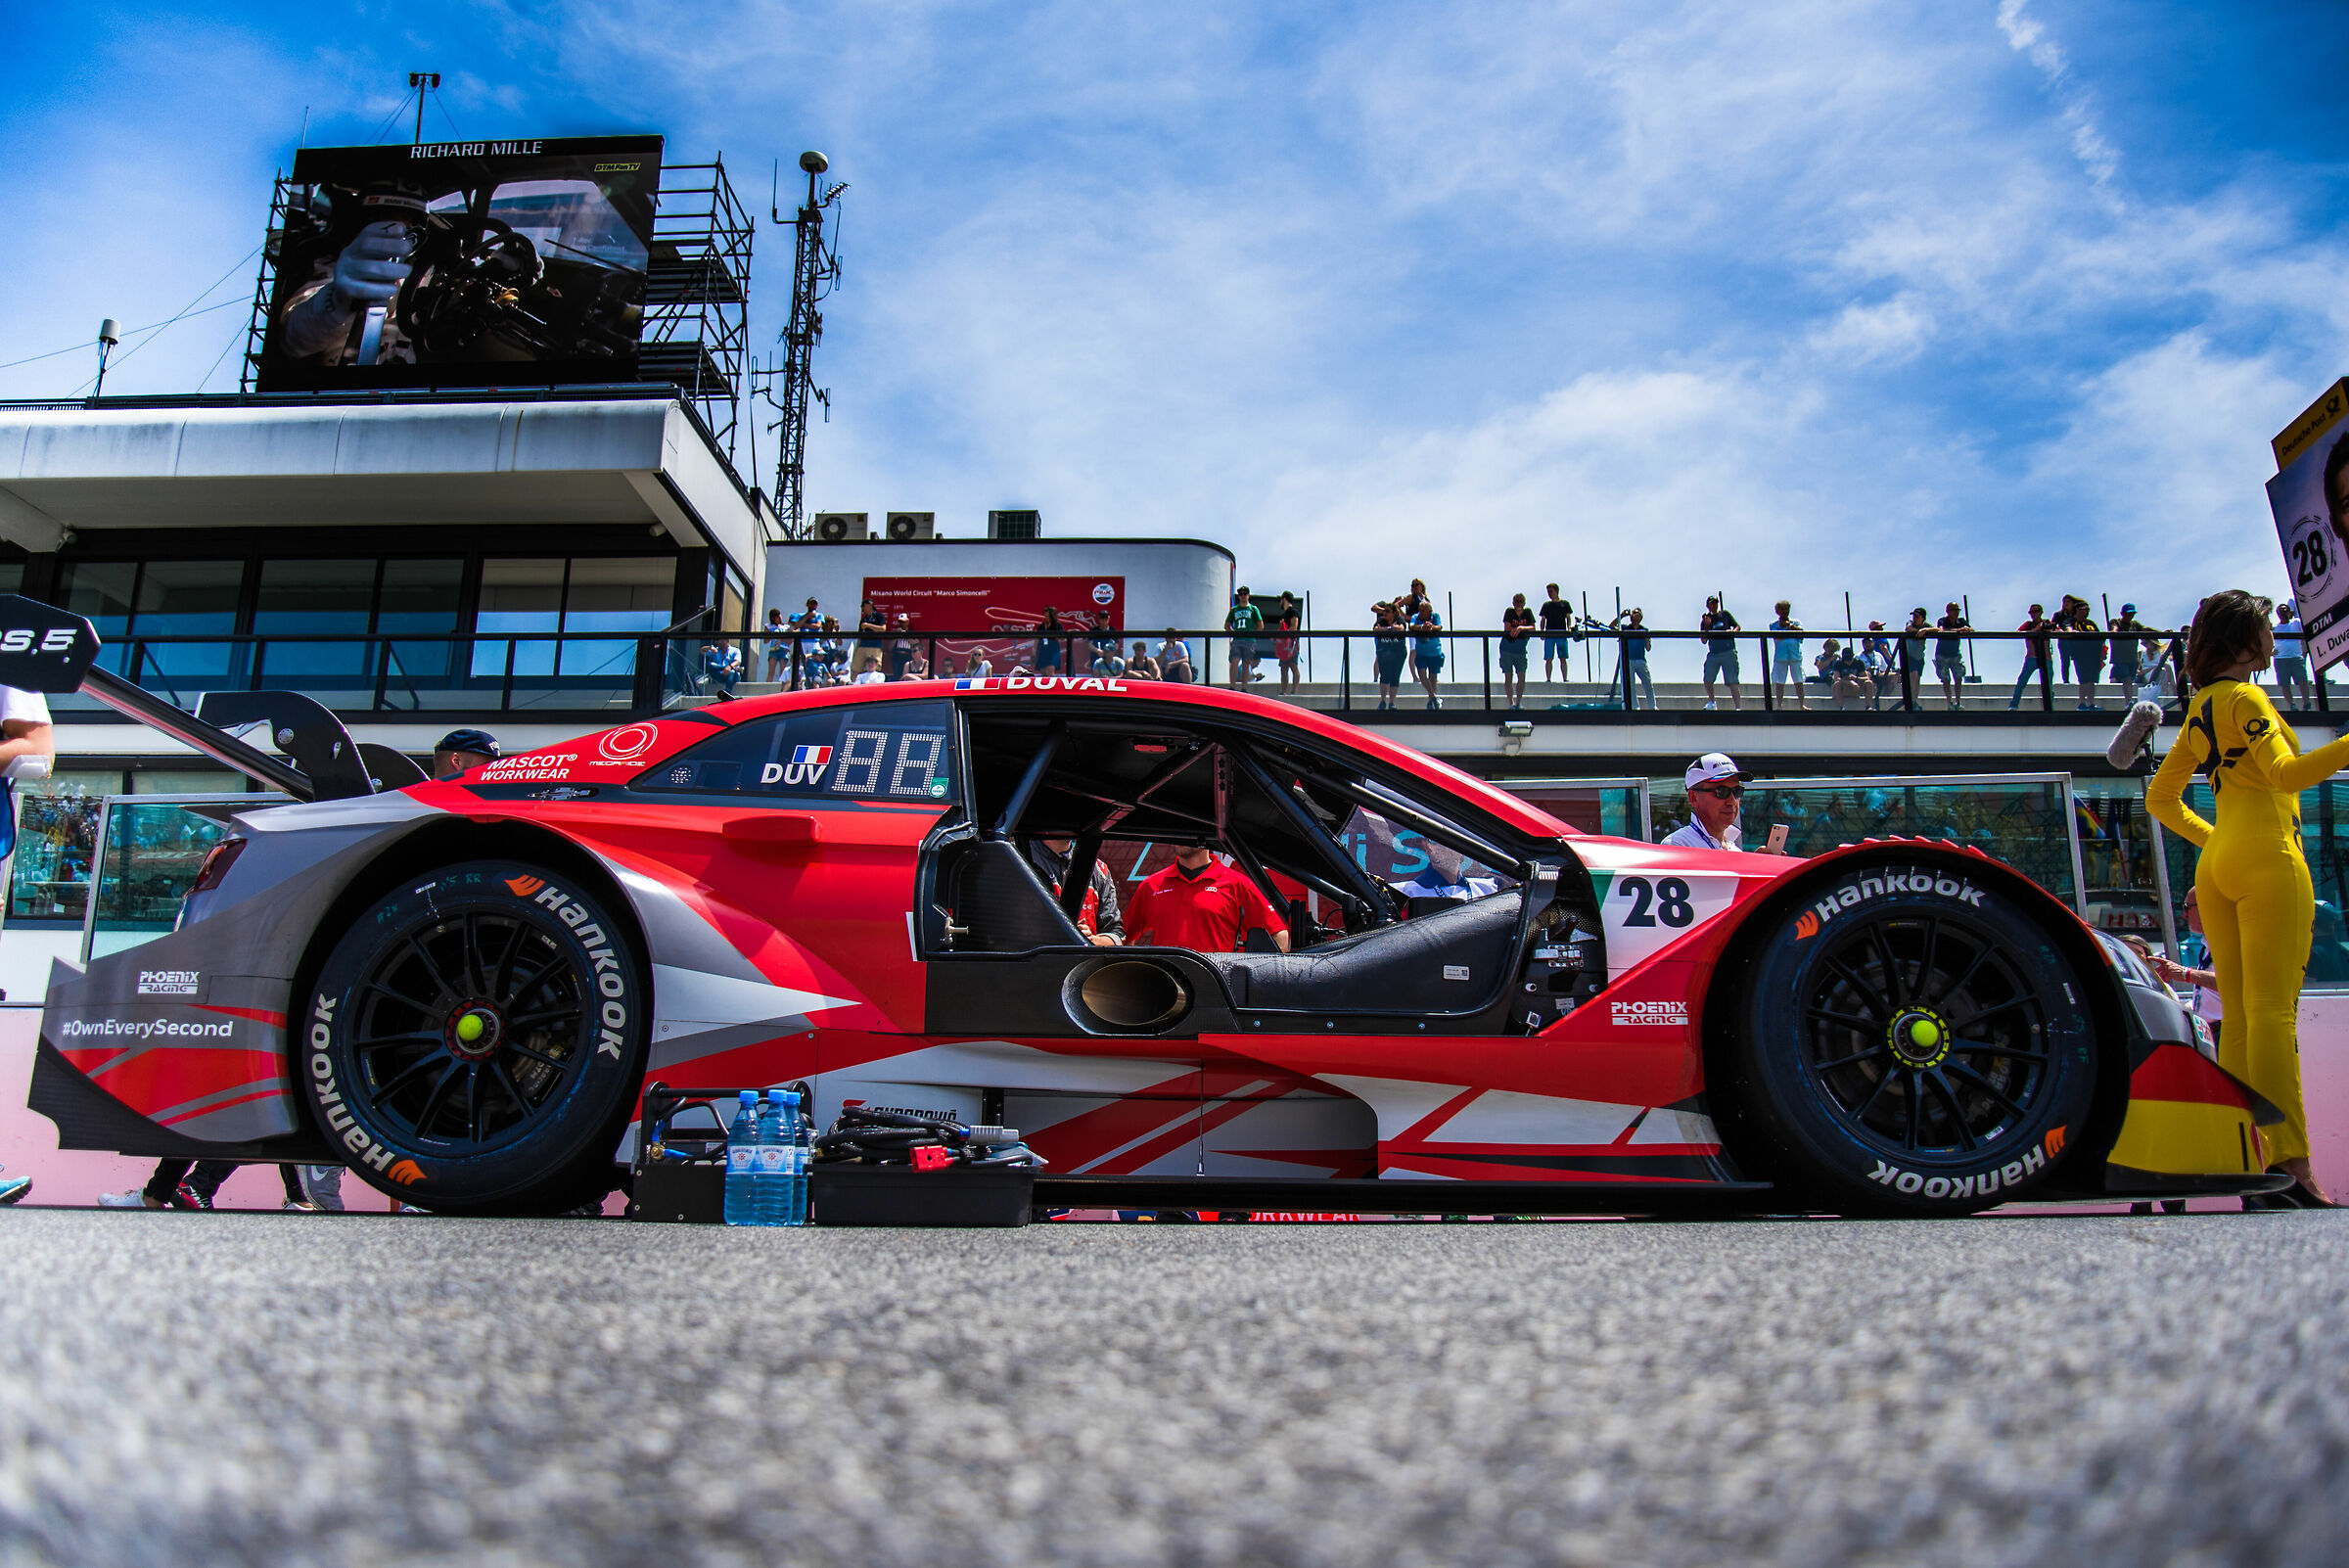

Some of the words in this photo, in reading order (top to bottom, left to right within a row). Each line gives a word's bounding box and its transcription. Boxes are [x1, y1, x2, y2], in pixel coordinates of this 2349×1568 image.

[410, 143, 485, 159] RICHARD
[490, 141, 543, 155] MILLE
[2292, 530, 2327, 587] 28
[1234, 609, 1252, 620] BOSTON
[1237, 618, 1246, 629] 11
[2312, 613, 2333, 634] DTM
[2317, 646, 2326, 658] L.
[1006, 677, 1128, 692] DUVAL
[480, 768, 570, 781] WORKWEAR
[760, 763, 827, 785] DUV
[1618, 876, 1694, 928] 28
[63, 1019, 234, 1038] #OwnEverySecond
